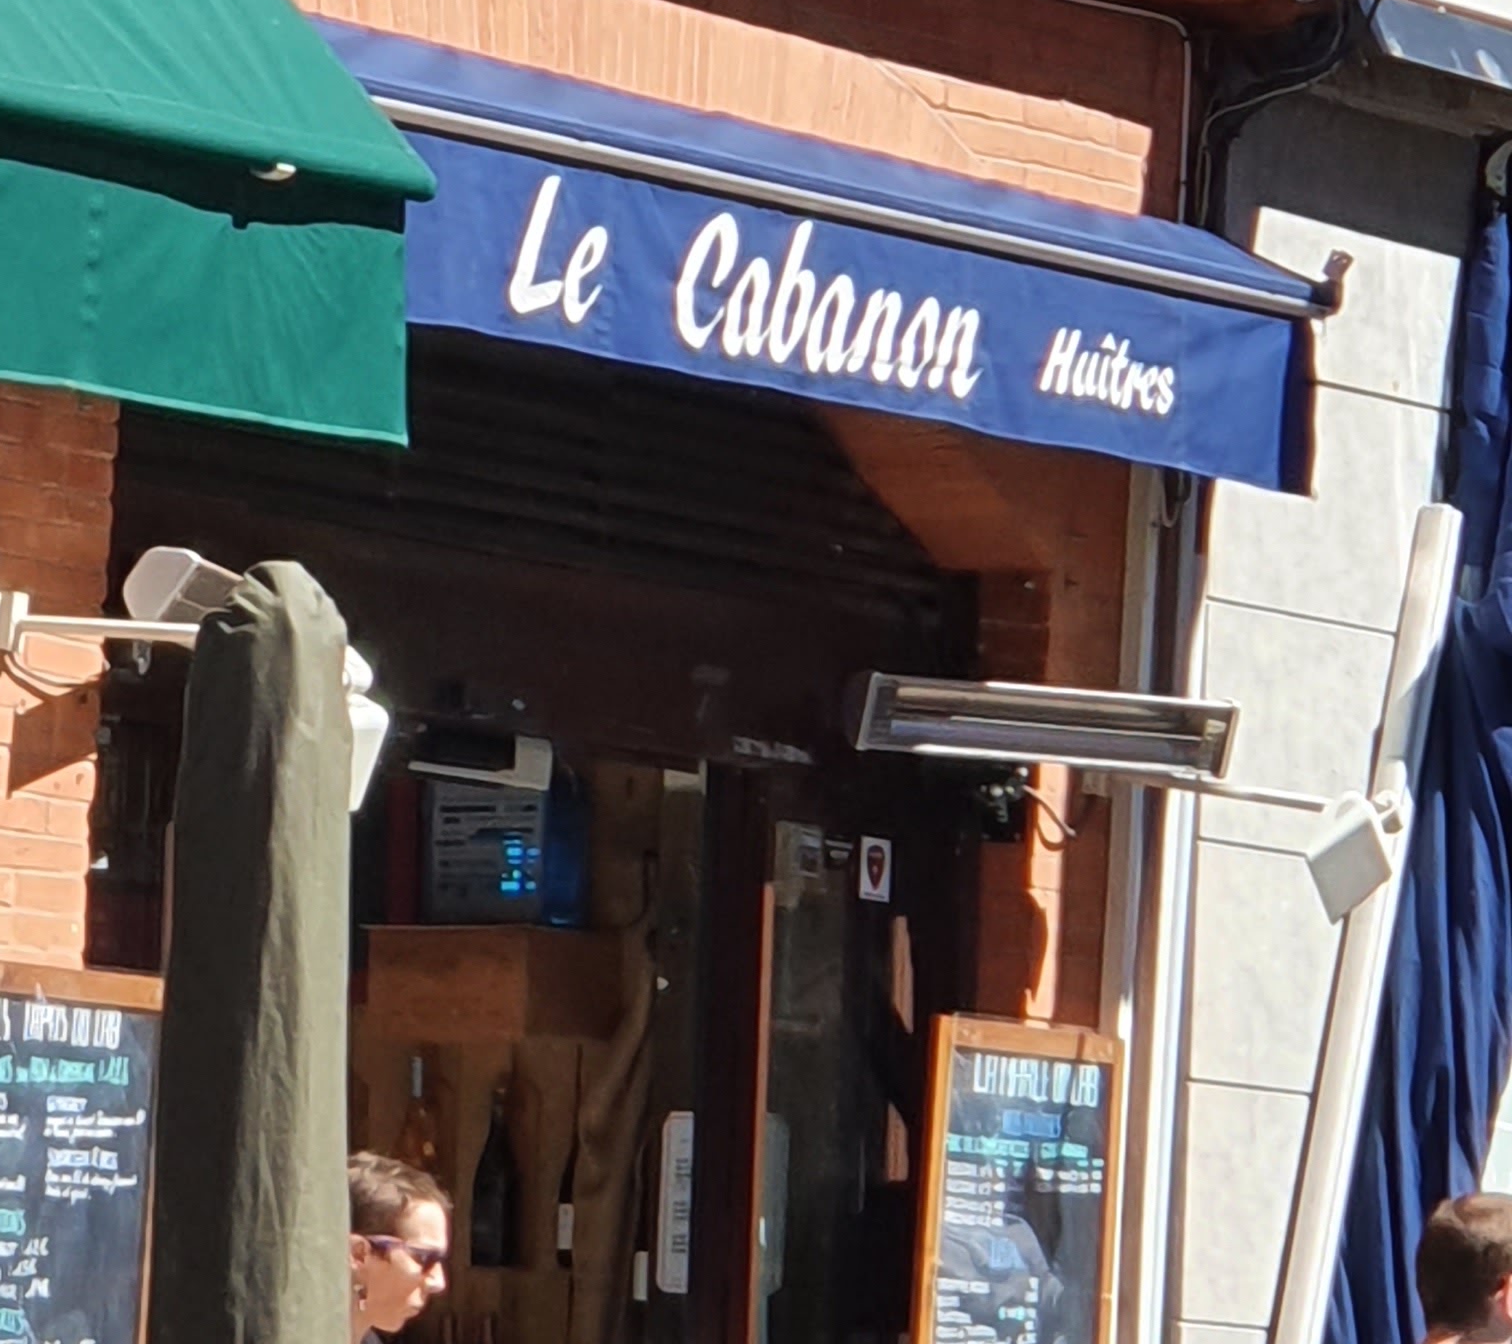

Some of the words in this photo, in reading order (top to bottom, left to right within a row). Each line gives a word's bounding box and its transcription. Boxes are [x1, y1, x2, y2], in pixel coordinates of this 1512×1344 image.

[508, 174, 609, 324] Le
[674, 211, 985, 399] Cabanon
[1039, 327, 1176, 416] Huîtres
